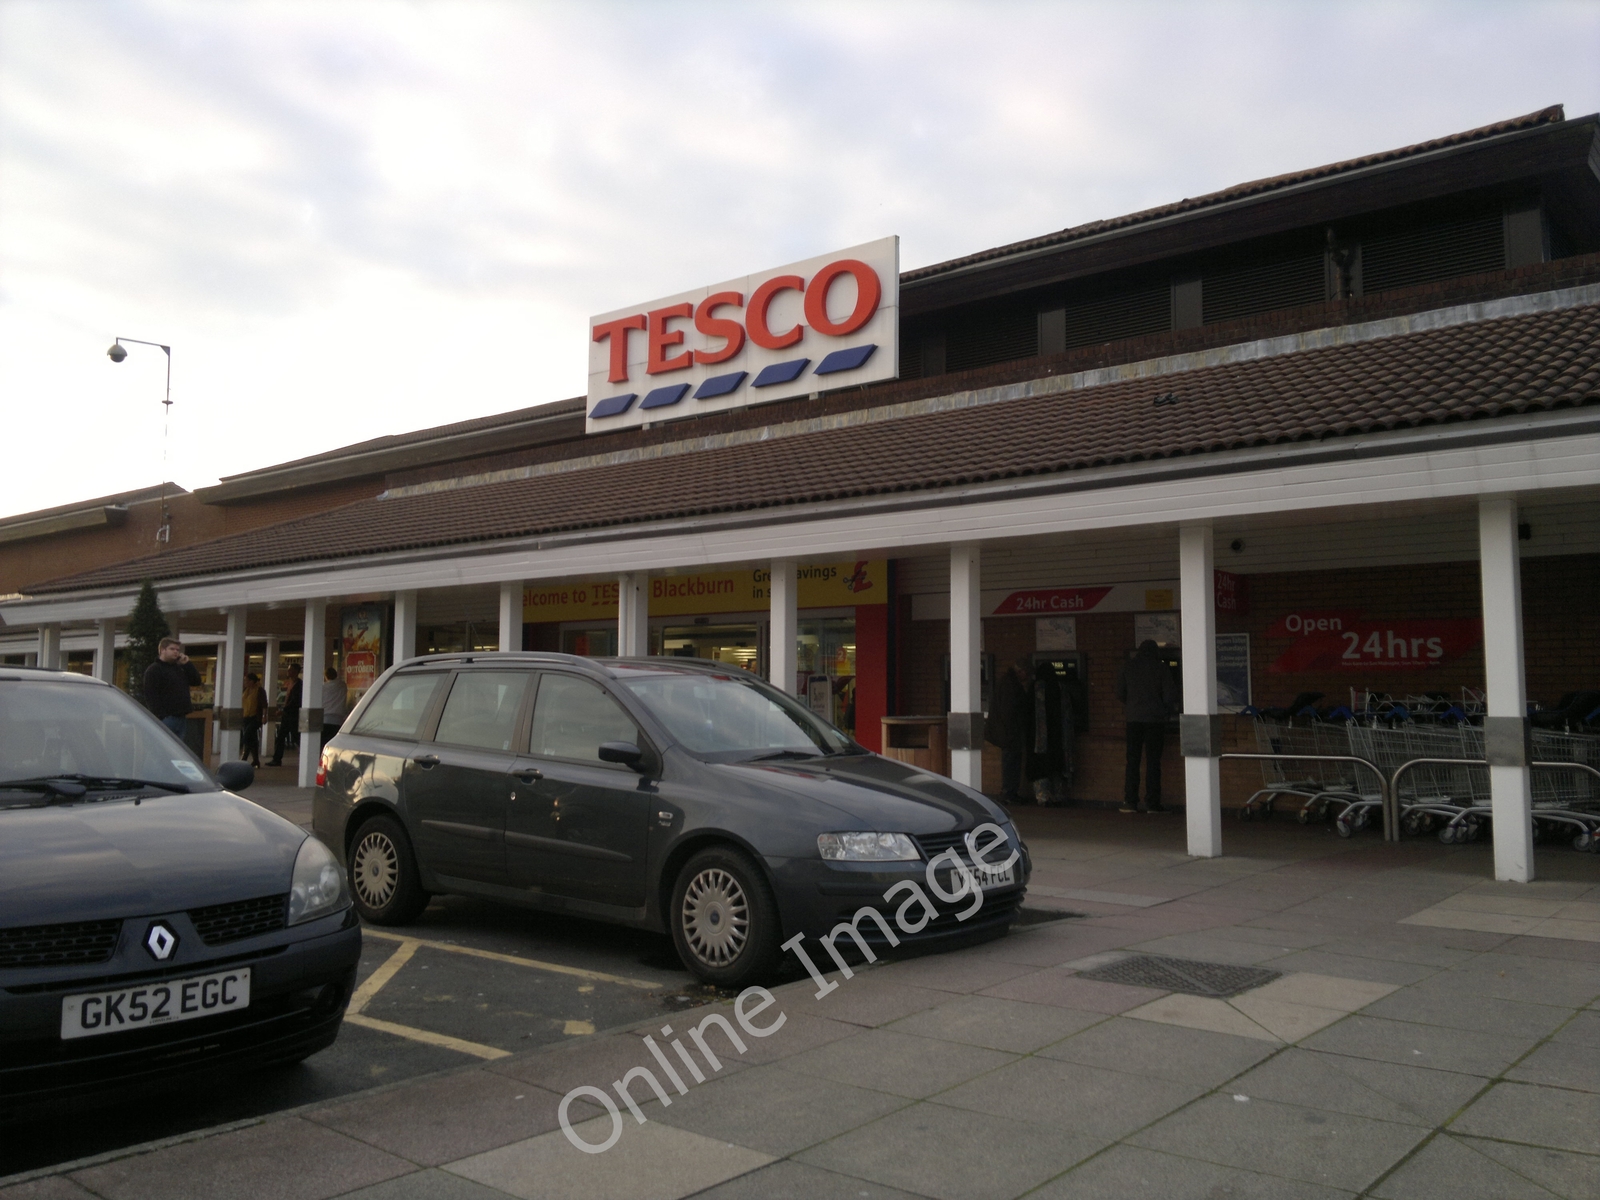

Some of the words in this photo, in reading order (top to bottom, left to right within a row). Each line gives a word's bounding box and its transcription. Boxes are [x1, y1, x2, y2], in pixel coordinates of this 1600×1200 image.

[592, 258, 882, 384] TESCO
[753, 569, 771, 582] Gre
[797, 565, 837, 581] avings
[1217, 572, 1235, 592] 24hr
[523, 589, 569, 607] elcome
[572, 588, 587, 604] to
[592, 583, 619, 599] TES
[652, 577, 734, 598] Blackburn
[752, 586, 763, 598] in
[1217, 592, 1237, 611] Cash
[1016, 596, 1047, 611] 24hr
[1050, 595, 1084, 610] Cash
[1285, 613, 1342, 635] Open
[1341, 630, 1444, 659] 24hrs
[991, 863, 1010, 883] FCL
[80, 986, 171, 1030] GK52
[180, 975, 238, 1015] EGC
